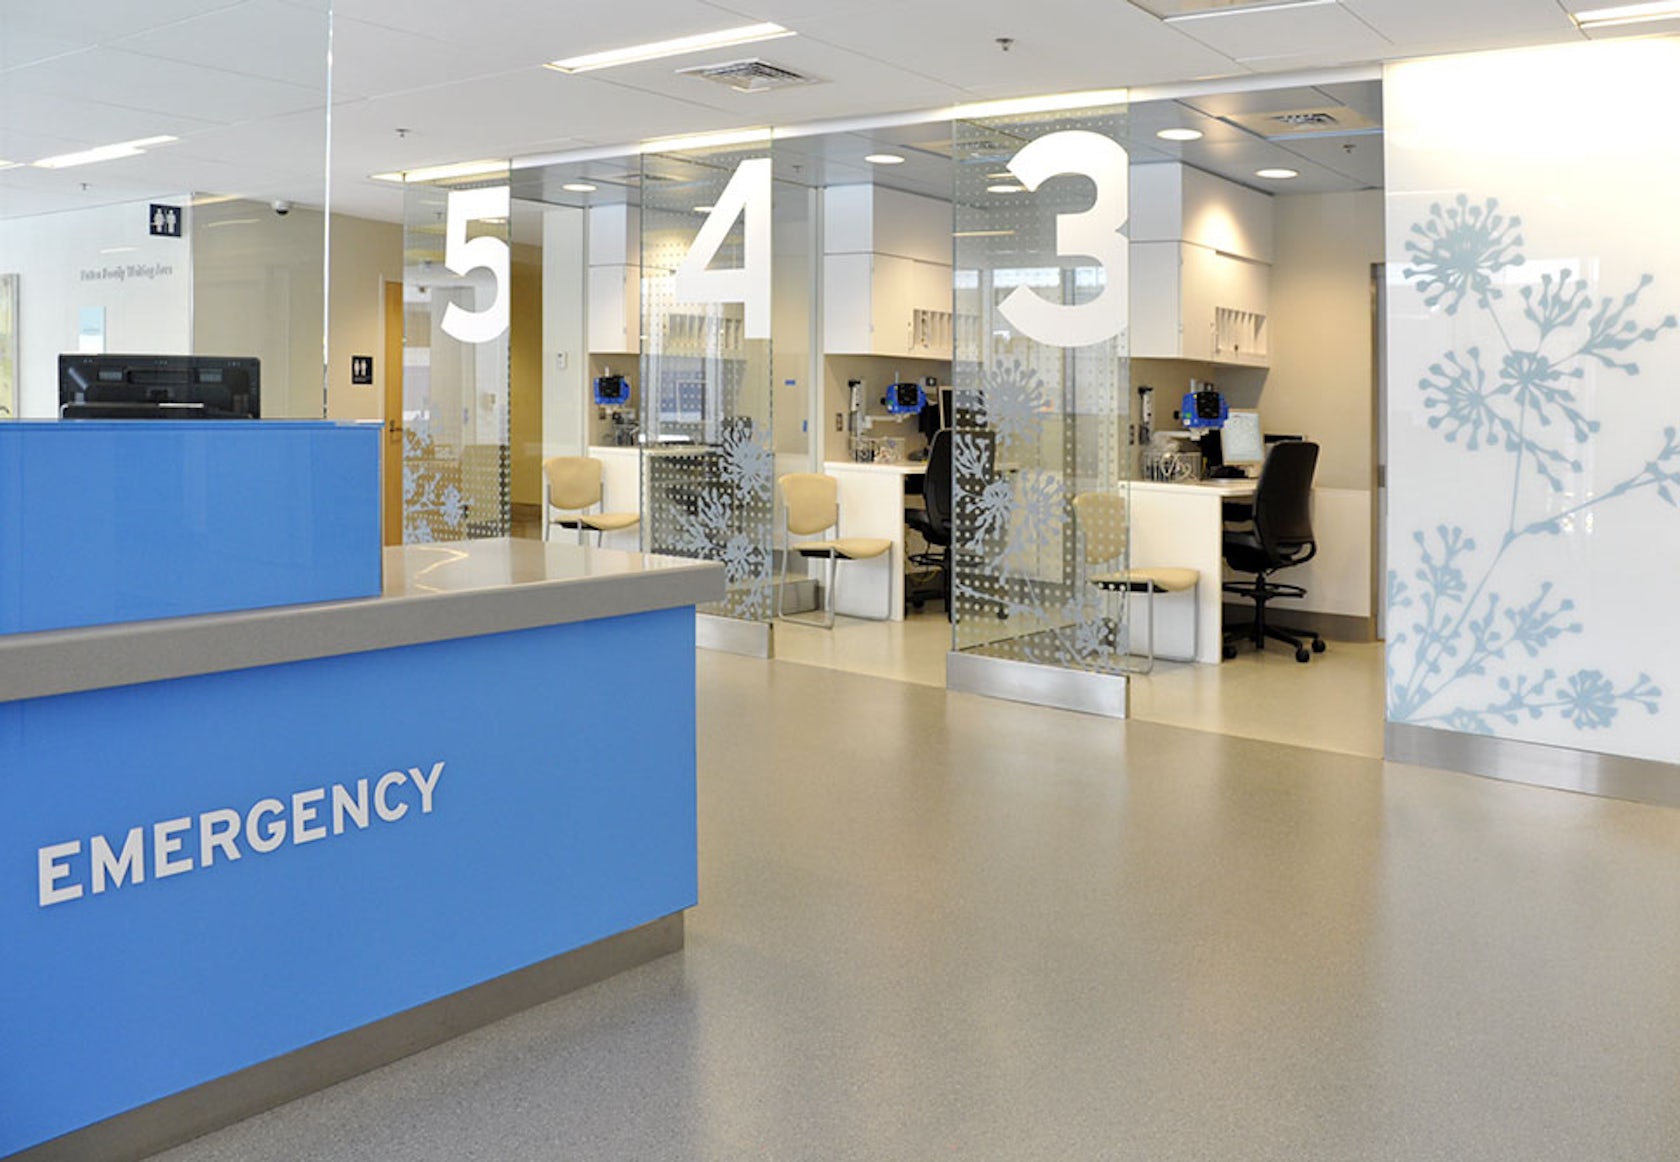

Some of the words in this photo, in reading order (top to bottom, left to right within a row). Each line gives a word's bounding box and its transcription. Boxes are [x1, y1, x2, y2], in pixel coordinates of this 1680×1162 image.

[441, 185, 510, 343] 5
[676, 158, 772, 339] 4
[998, 130, 1128, 347] 3
[38, 761, 445, 906] EMERGENCY
